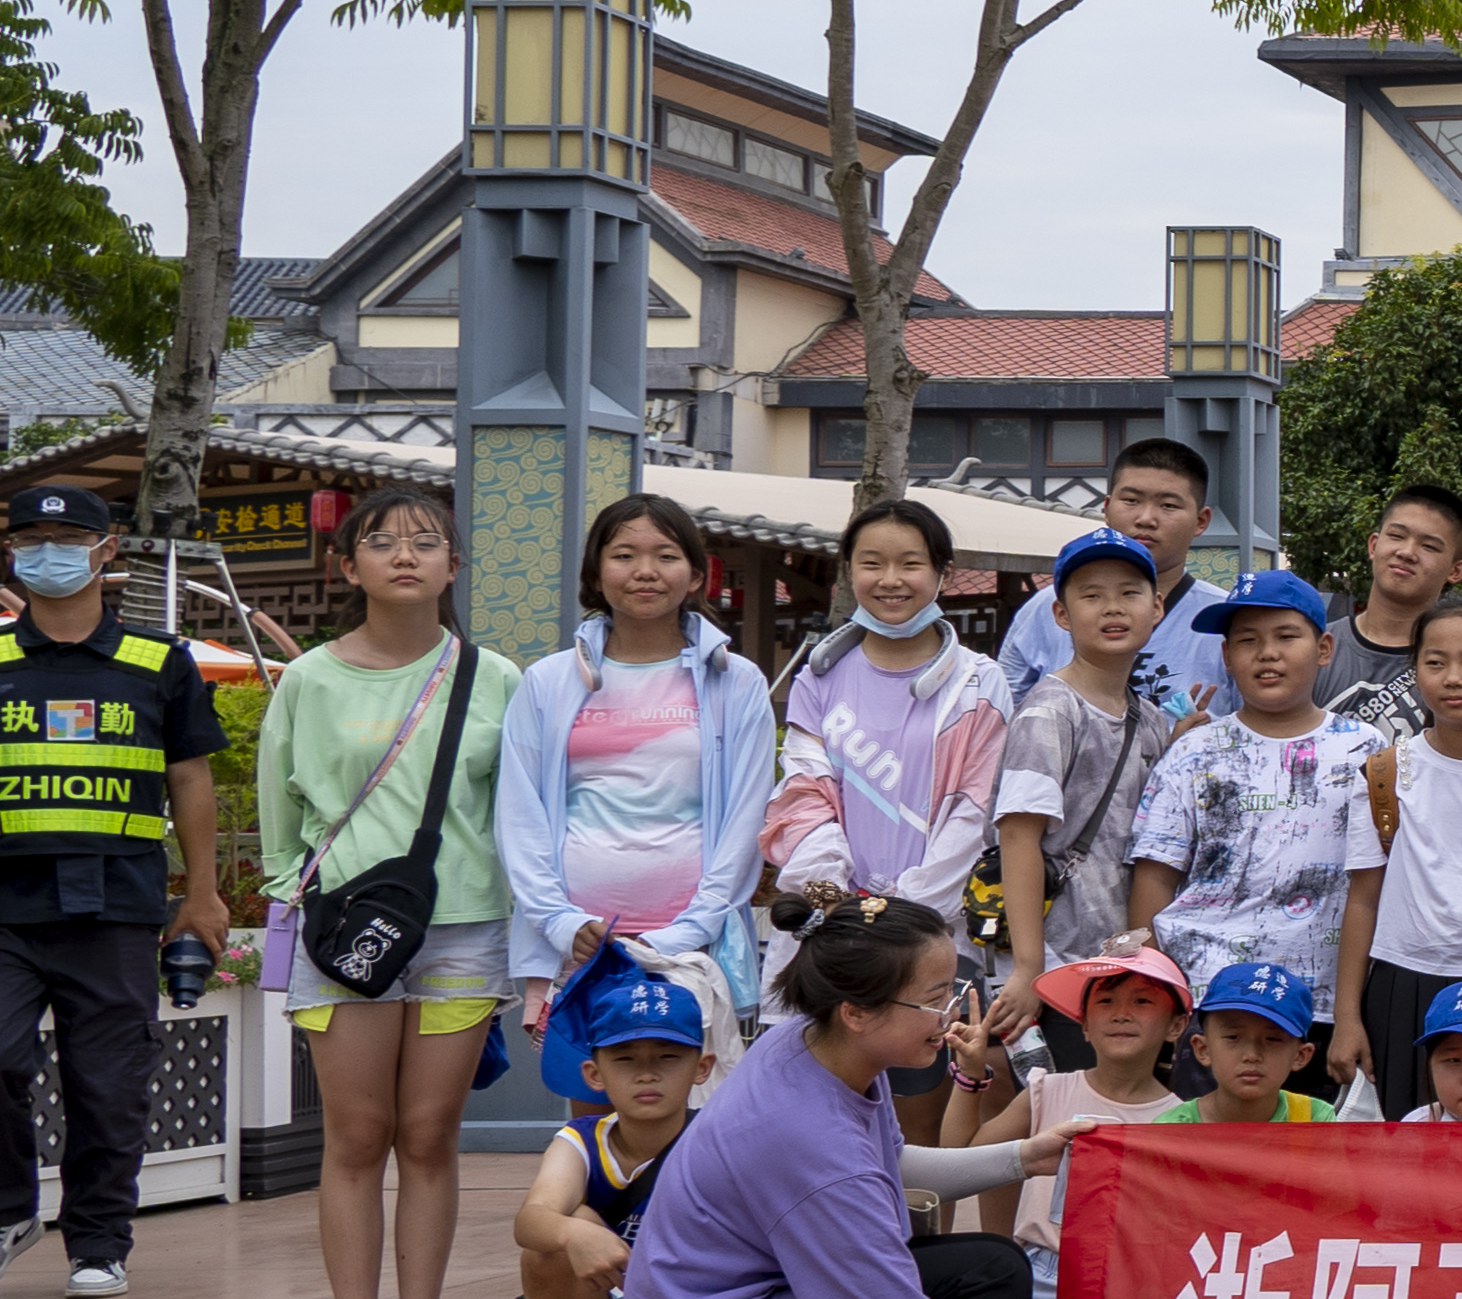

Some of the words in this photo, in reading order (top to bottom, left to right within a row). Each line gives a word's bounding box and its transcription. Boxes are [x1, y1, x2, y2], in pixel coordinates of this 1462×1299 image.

[1, 700, 40, 733] 执
[99, 702, 136, 736] 勤
[0, 774, 132, 803] ZHIQIN
[370, 917, 402, 940] Hello
